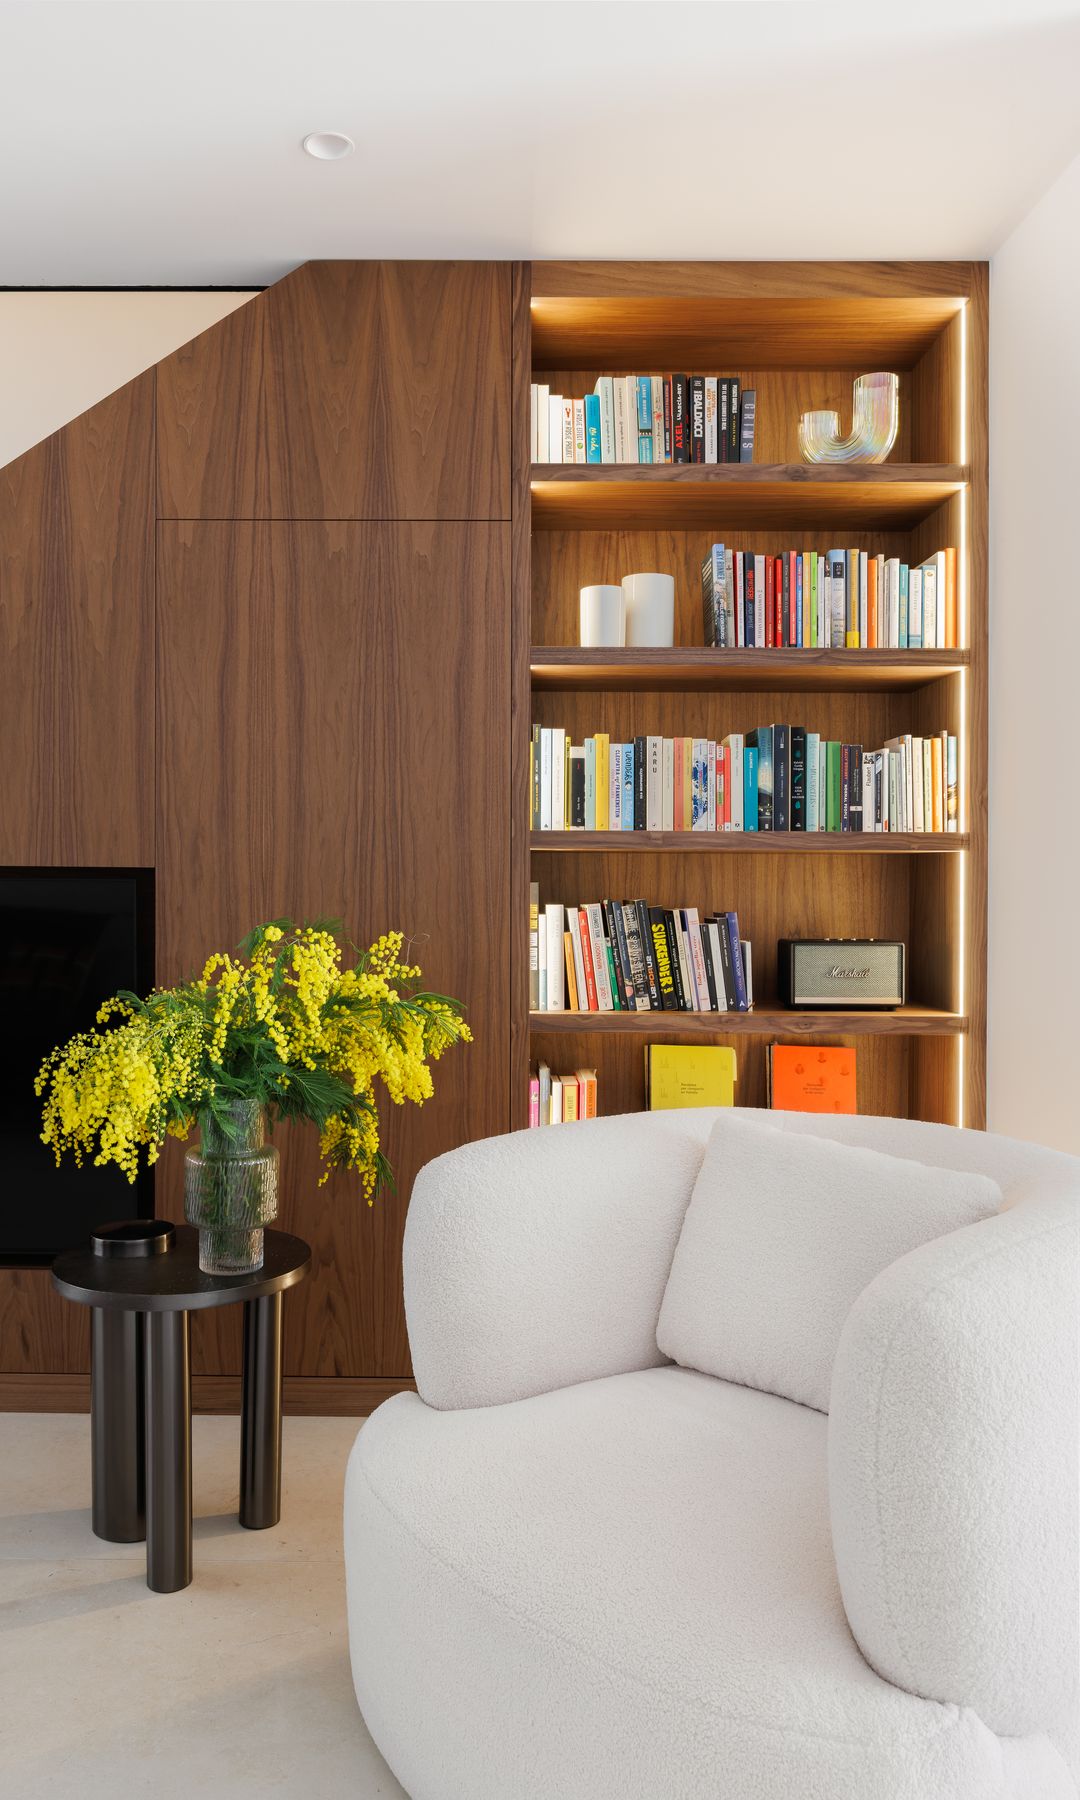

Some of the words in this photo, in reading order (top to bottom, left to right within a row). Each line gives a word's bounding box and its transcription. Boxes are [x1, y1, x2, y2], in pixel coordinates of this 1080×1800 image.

[694, 394, 702, 438] BALDACCI
[742, 404, 754, 448] CRIMS
[624, 909, 636, 933] BRUCE
[628, 934, 646, 983] SPRINGSTEEN
[826, 966, 870, 978] Marshall
